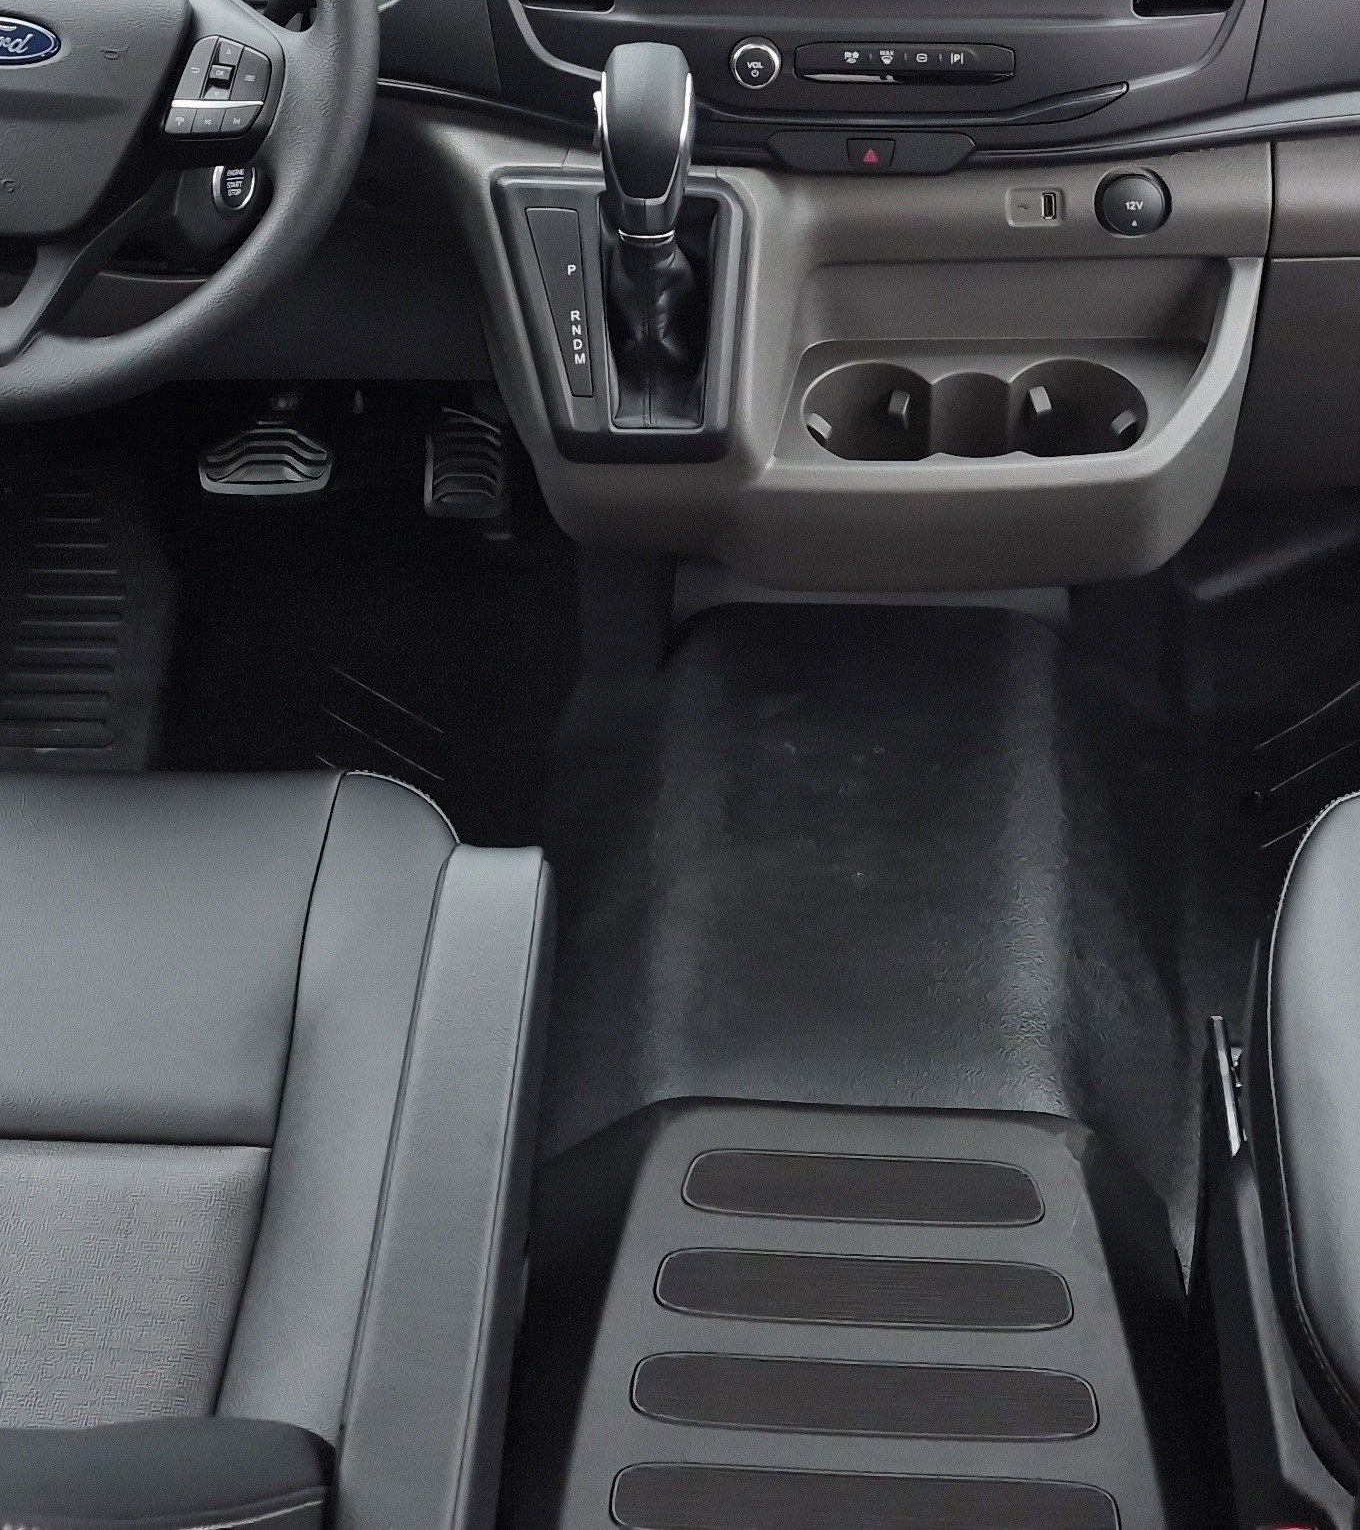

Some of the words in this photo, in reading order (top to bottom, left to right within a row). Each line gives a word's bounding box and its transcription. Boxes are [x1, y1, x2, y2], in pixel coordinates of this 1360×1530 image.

[747, 61, 764, 70] VOL
[1125, 200, 1144, 211] 12V
[567, 264, 577, 276] P
[570, 310, 580, 321] R
[571, 325, 581, 335] N
[572, 339, 583, 350] D
[574, 353, 586, 364] M
